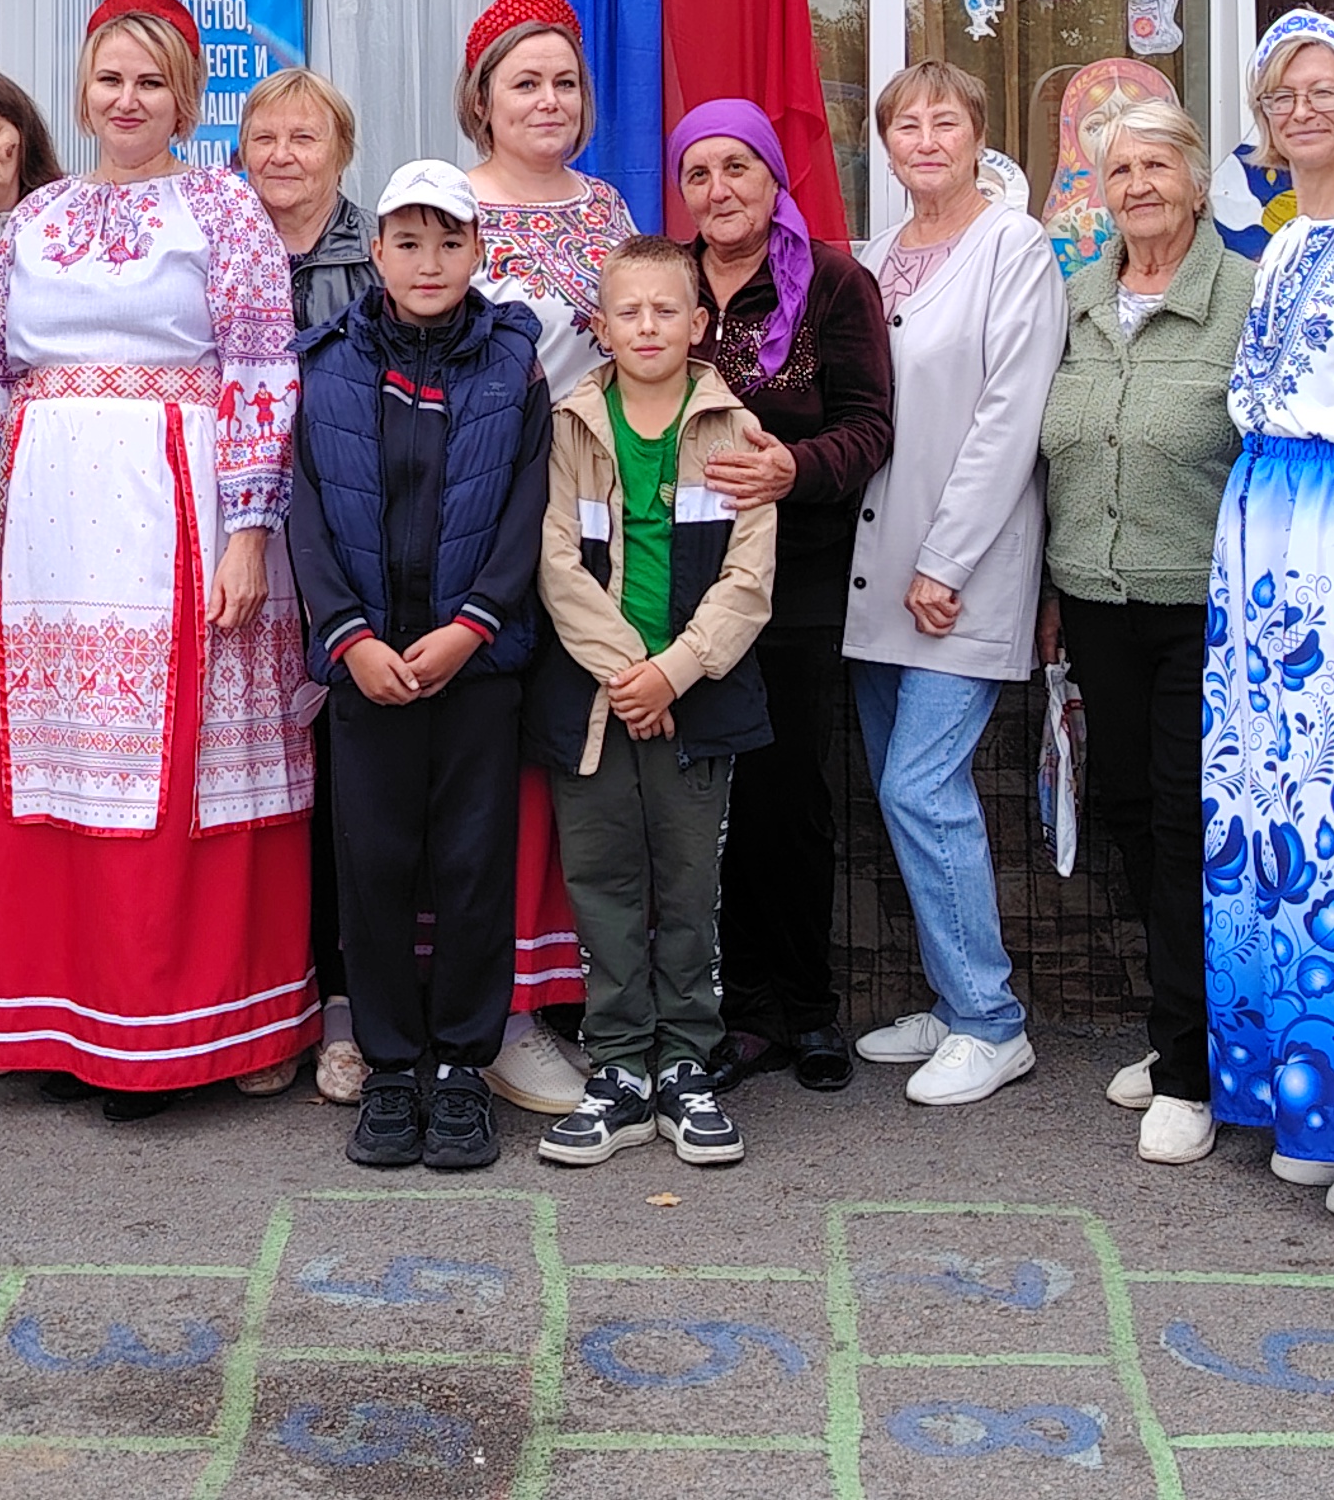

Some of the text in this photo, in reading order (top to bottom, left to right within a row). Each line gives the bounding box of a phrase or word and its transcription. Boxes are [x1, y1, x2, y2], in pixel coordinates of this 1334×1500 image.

[201, 43, 269, 78] ЕСТЕ И
[8, 1315, 224, 1371] 3
[886, 1397, 1103, 1459] 8
